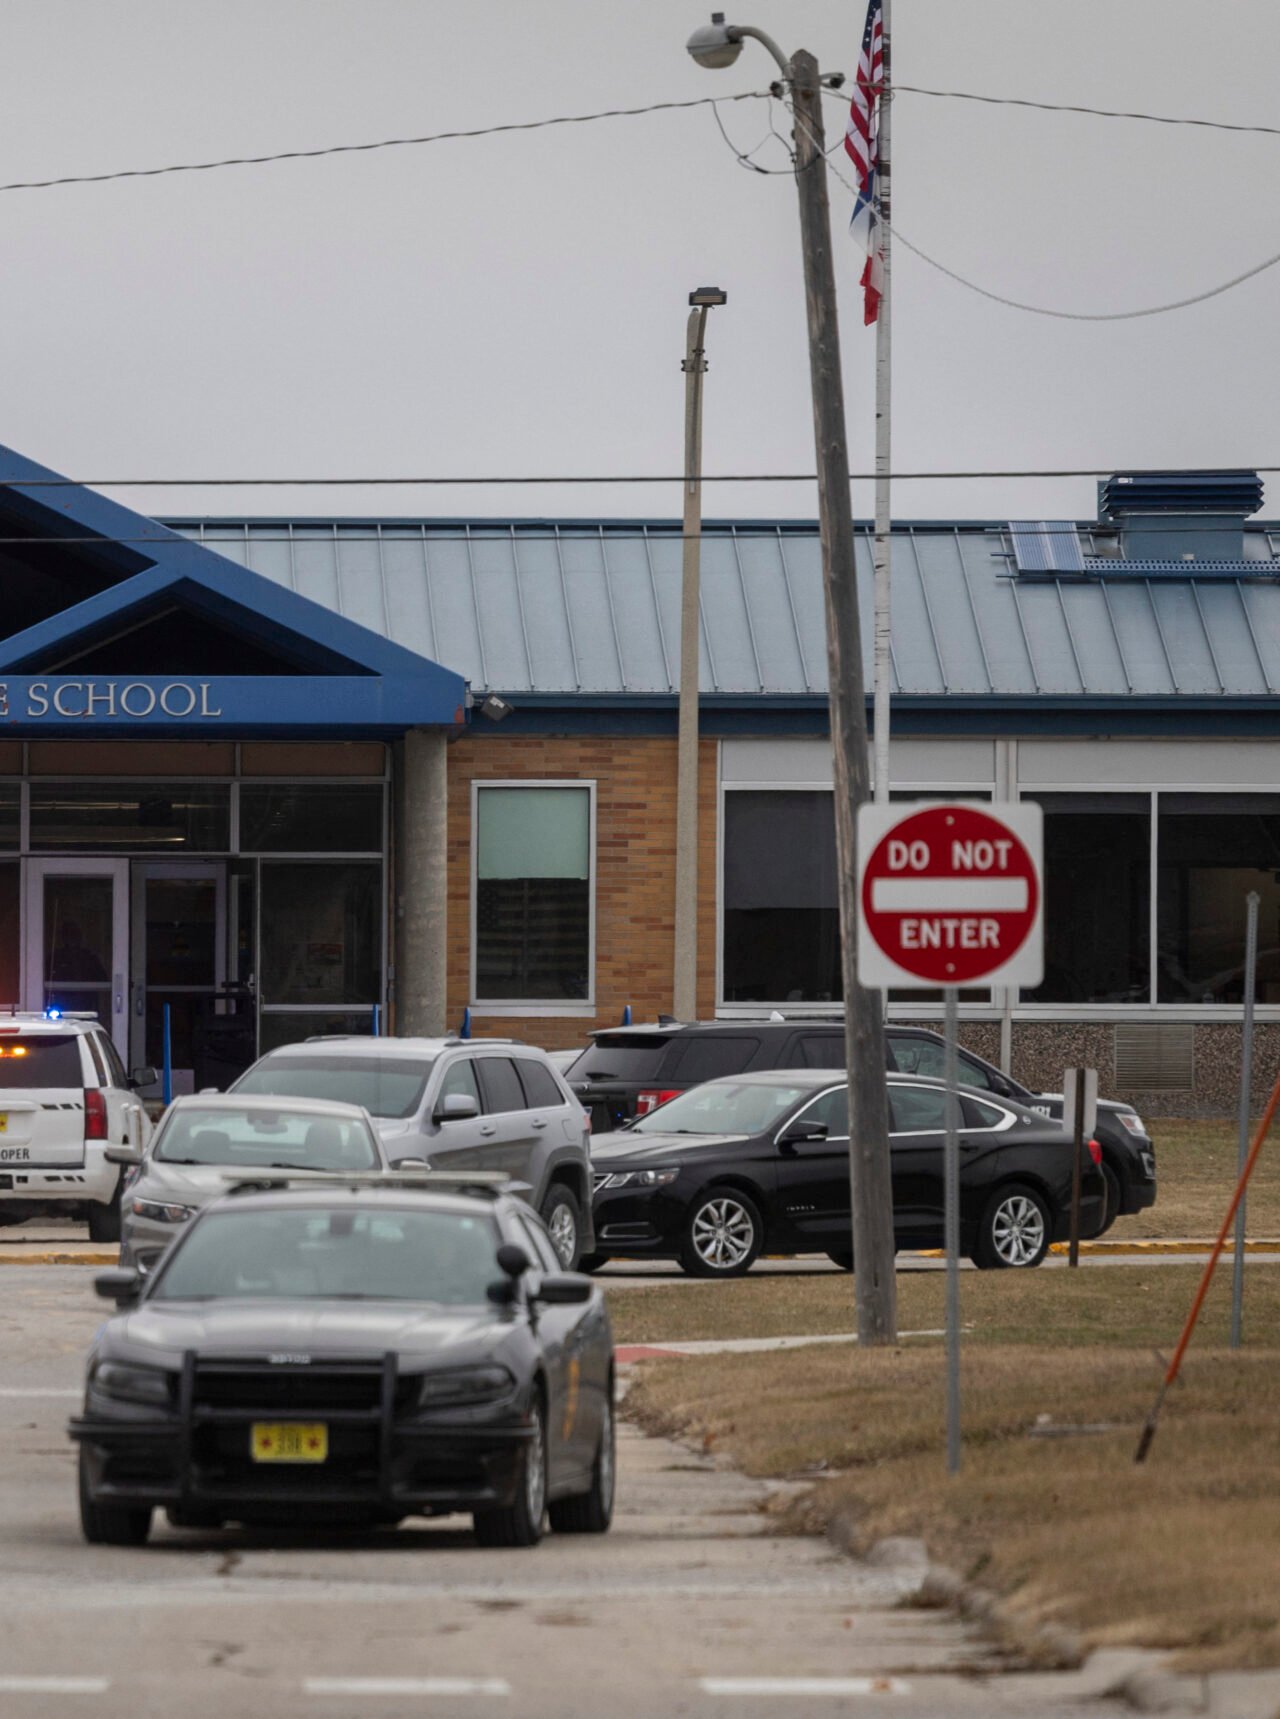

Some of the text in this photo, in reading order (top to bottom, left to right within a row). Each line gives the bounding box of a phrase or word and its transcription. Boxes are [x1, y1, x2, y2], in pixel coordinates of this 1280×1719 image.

[27, 682, 221, 717] SCHOOL
[887, 839, 1013, 871] DO NOT
[900, 918, 1000, 949] ENTER
